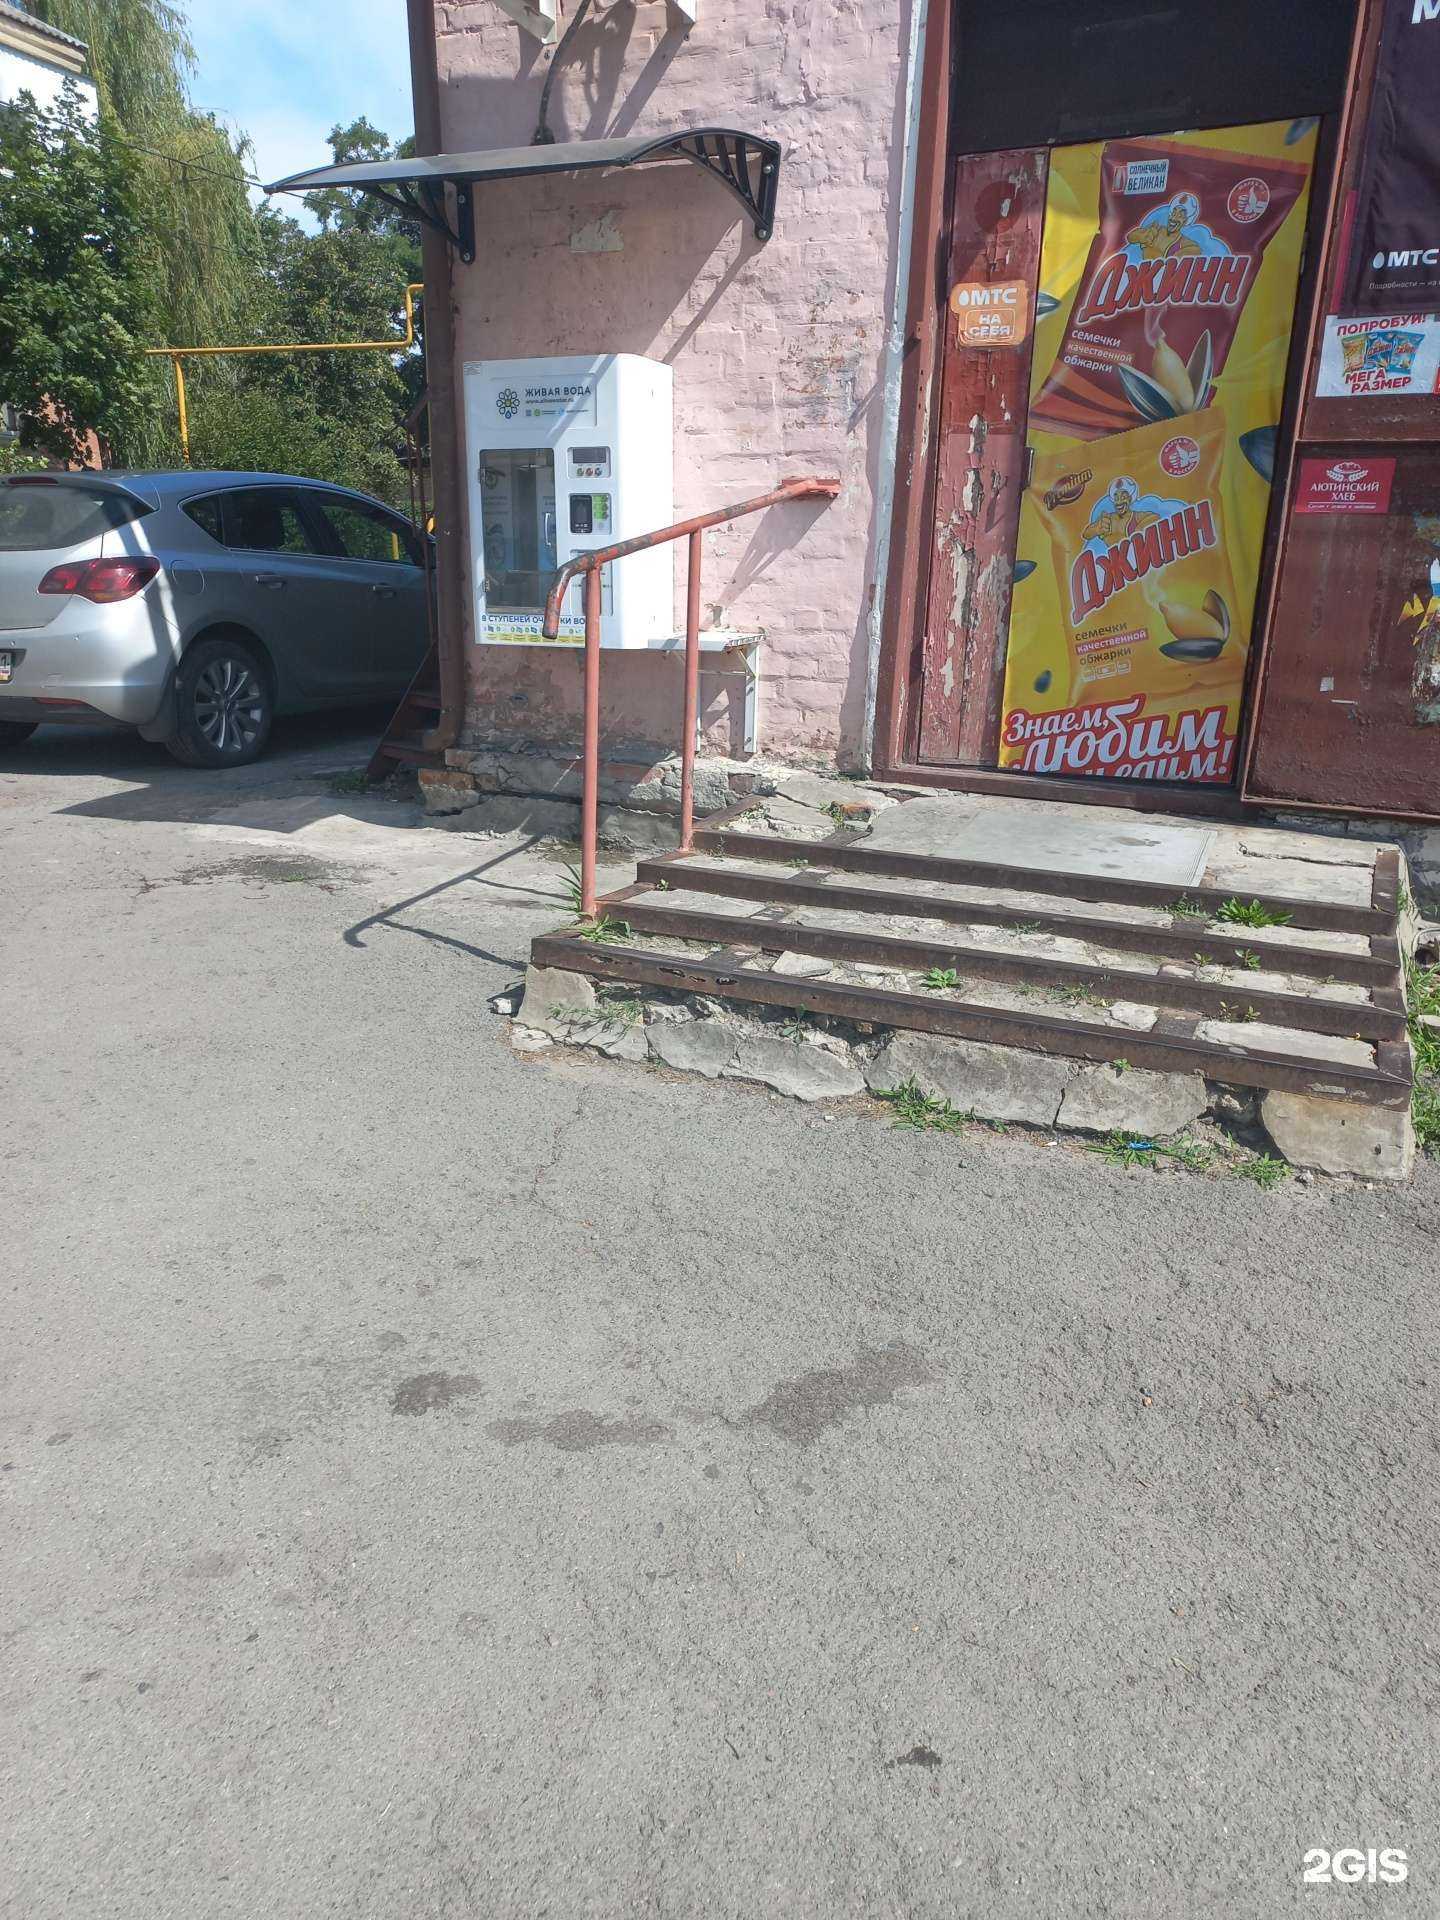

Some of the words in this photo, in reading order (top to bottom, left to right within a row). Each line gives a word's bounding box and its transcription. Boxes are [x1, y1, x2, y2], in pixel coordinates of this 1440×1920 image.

[1127, 175, 1166, 191] ВЕЛИКАН
[1387, 248, 1440, 268] МТС
[971, 287, 1018, 305] МТС
[979, 313, 1001, 324] НА
[1337, 312, 1426, 337] ПОПРОБУЙ!
[970, 325, 1010, 336] СЕБЯ
[1071, 329, 1121, 348] семечки
[1067, 343, 1132, 363] качественной
[1063, 354, 1113, 373] обжарки
[1345, 368, 1386, 385] МЕГА
[1351, 376, 1412, 394] РАЗМЕР
[525, 386, 561, 398] ЖИВАЯ
[563, 385, 591, 397] ВОДА
[1310, 481, 1380, 492] АЮТИНСКИЙ
[1331, 492, 1357, 501] ХЛЕБ
[488, 614, 531, 624] СТУПЕНЕЙ
[532, 616, 572, 625] ОЧКИ
[1075, 622, 1128, 641] семечки
[1077, 630, 1147, 654] качественной
[1080, 647, 1132, 665] обжарки
[1006, 707, 1109, 743] Знаем,
